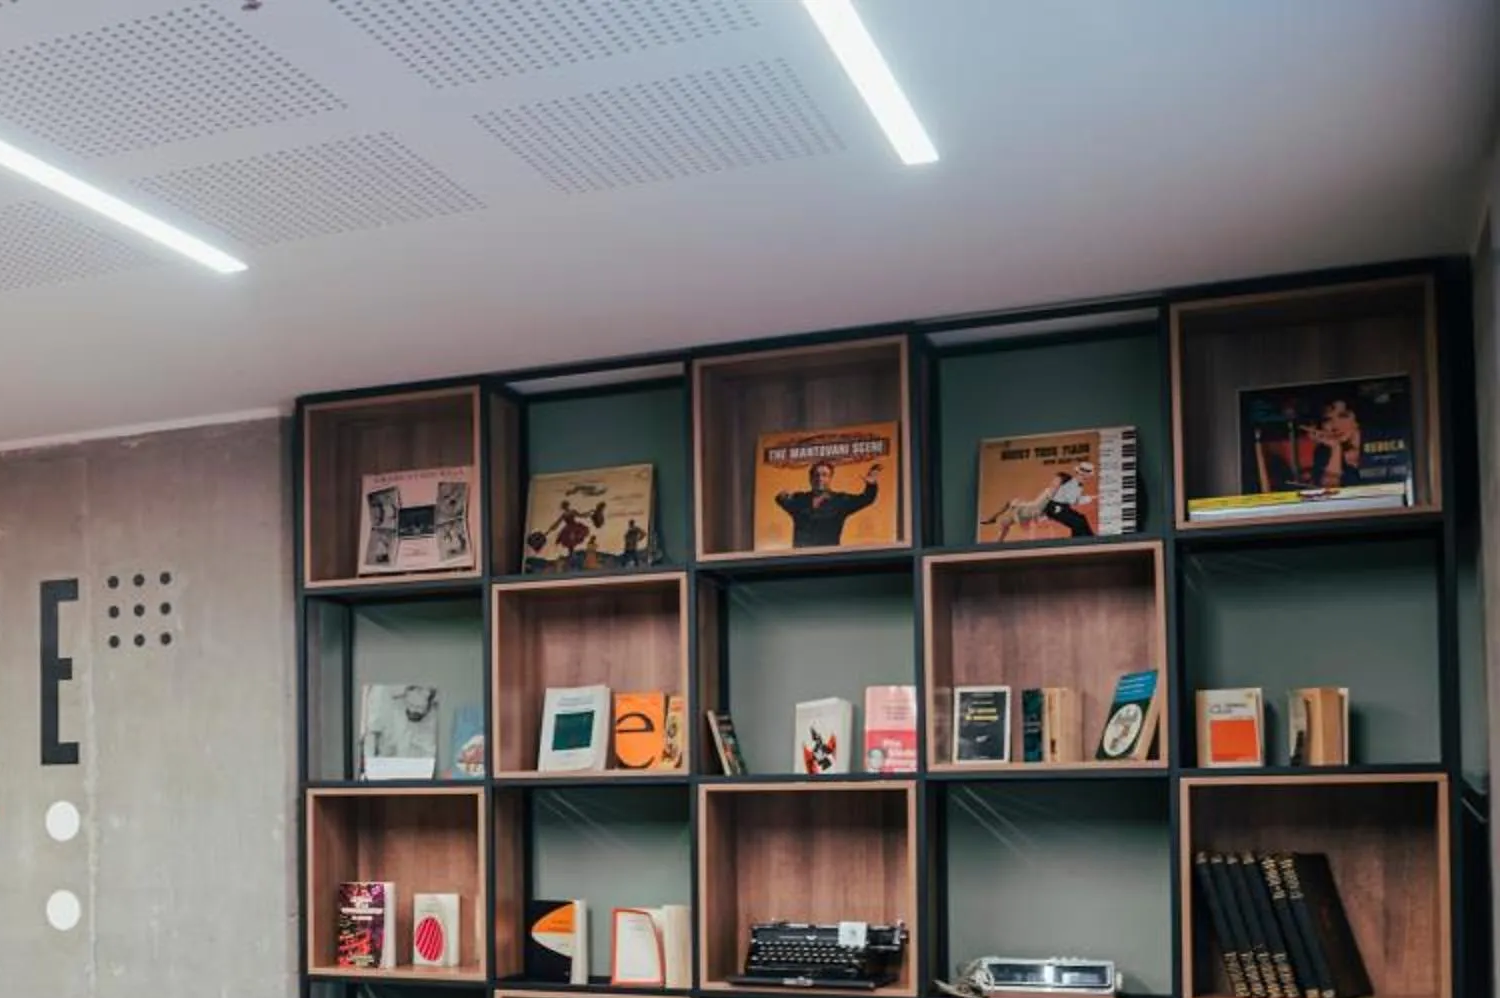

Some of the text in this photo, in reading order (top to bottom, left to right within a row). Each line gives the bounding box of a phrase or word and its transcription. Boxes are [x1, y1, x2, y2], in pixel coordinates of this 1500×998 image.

[768, 440, 883, 461] THE MANTOVANI SCENE
